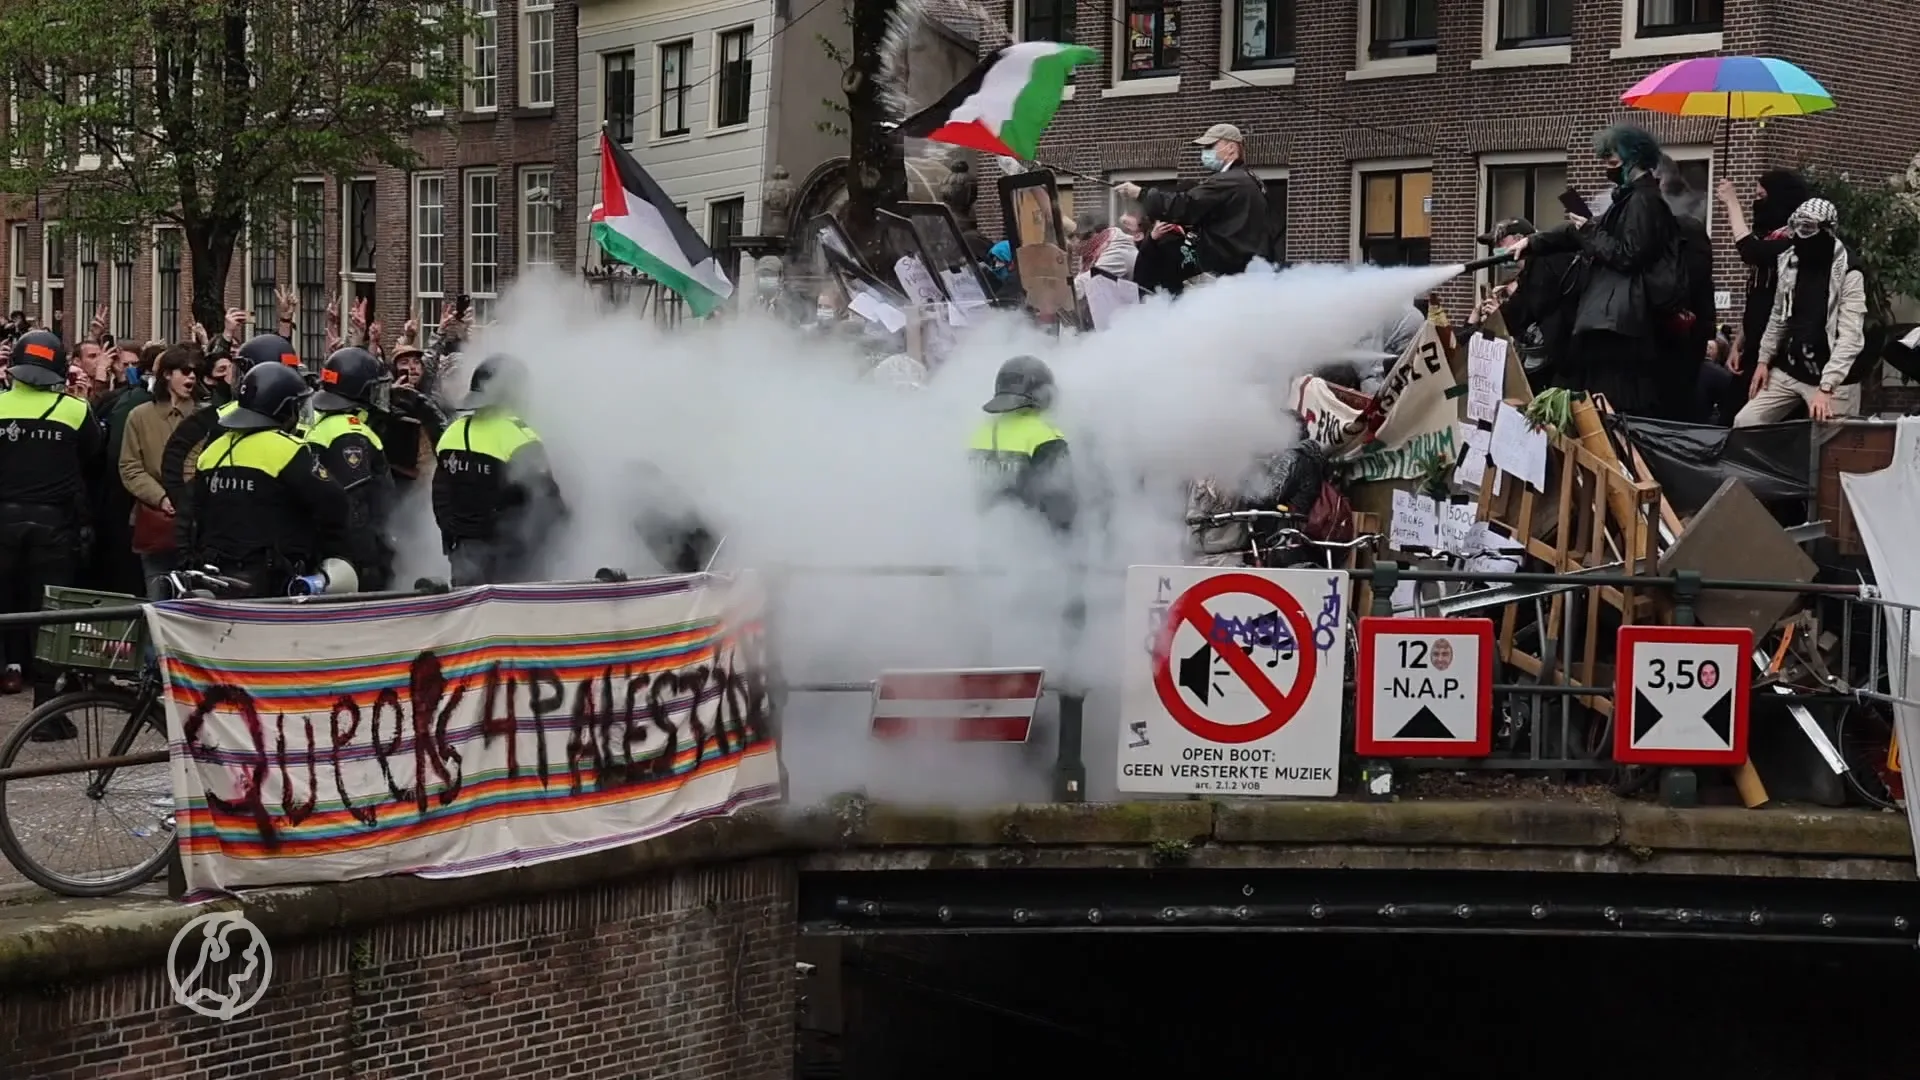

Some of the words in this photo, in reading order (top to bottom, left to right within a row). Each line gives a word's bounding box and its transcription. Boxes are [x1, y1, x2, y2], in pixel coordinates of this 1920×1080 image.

[0, 420, 62, 443] POITIE
[480, 660, 522, 780] 4
[1182, 748, 1224, 762] OPEN
[1229, 749, 1276, 763] BOOT:
[1123, 764, 1164, 777] GEEN
[1171, 765, 1269, 779] VERSTERKTE
[1275, 767, 1333, 781] MUZIEK
[1195, 782, 1212, 790] art.
[1216, 781, 1237, 790] 2.1.2
